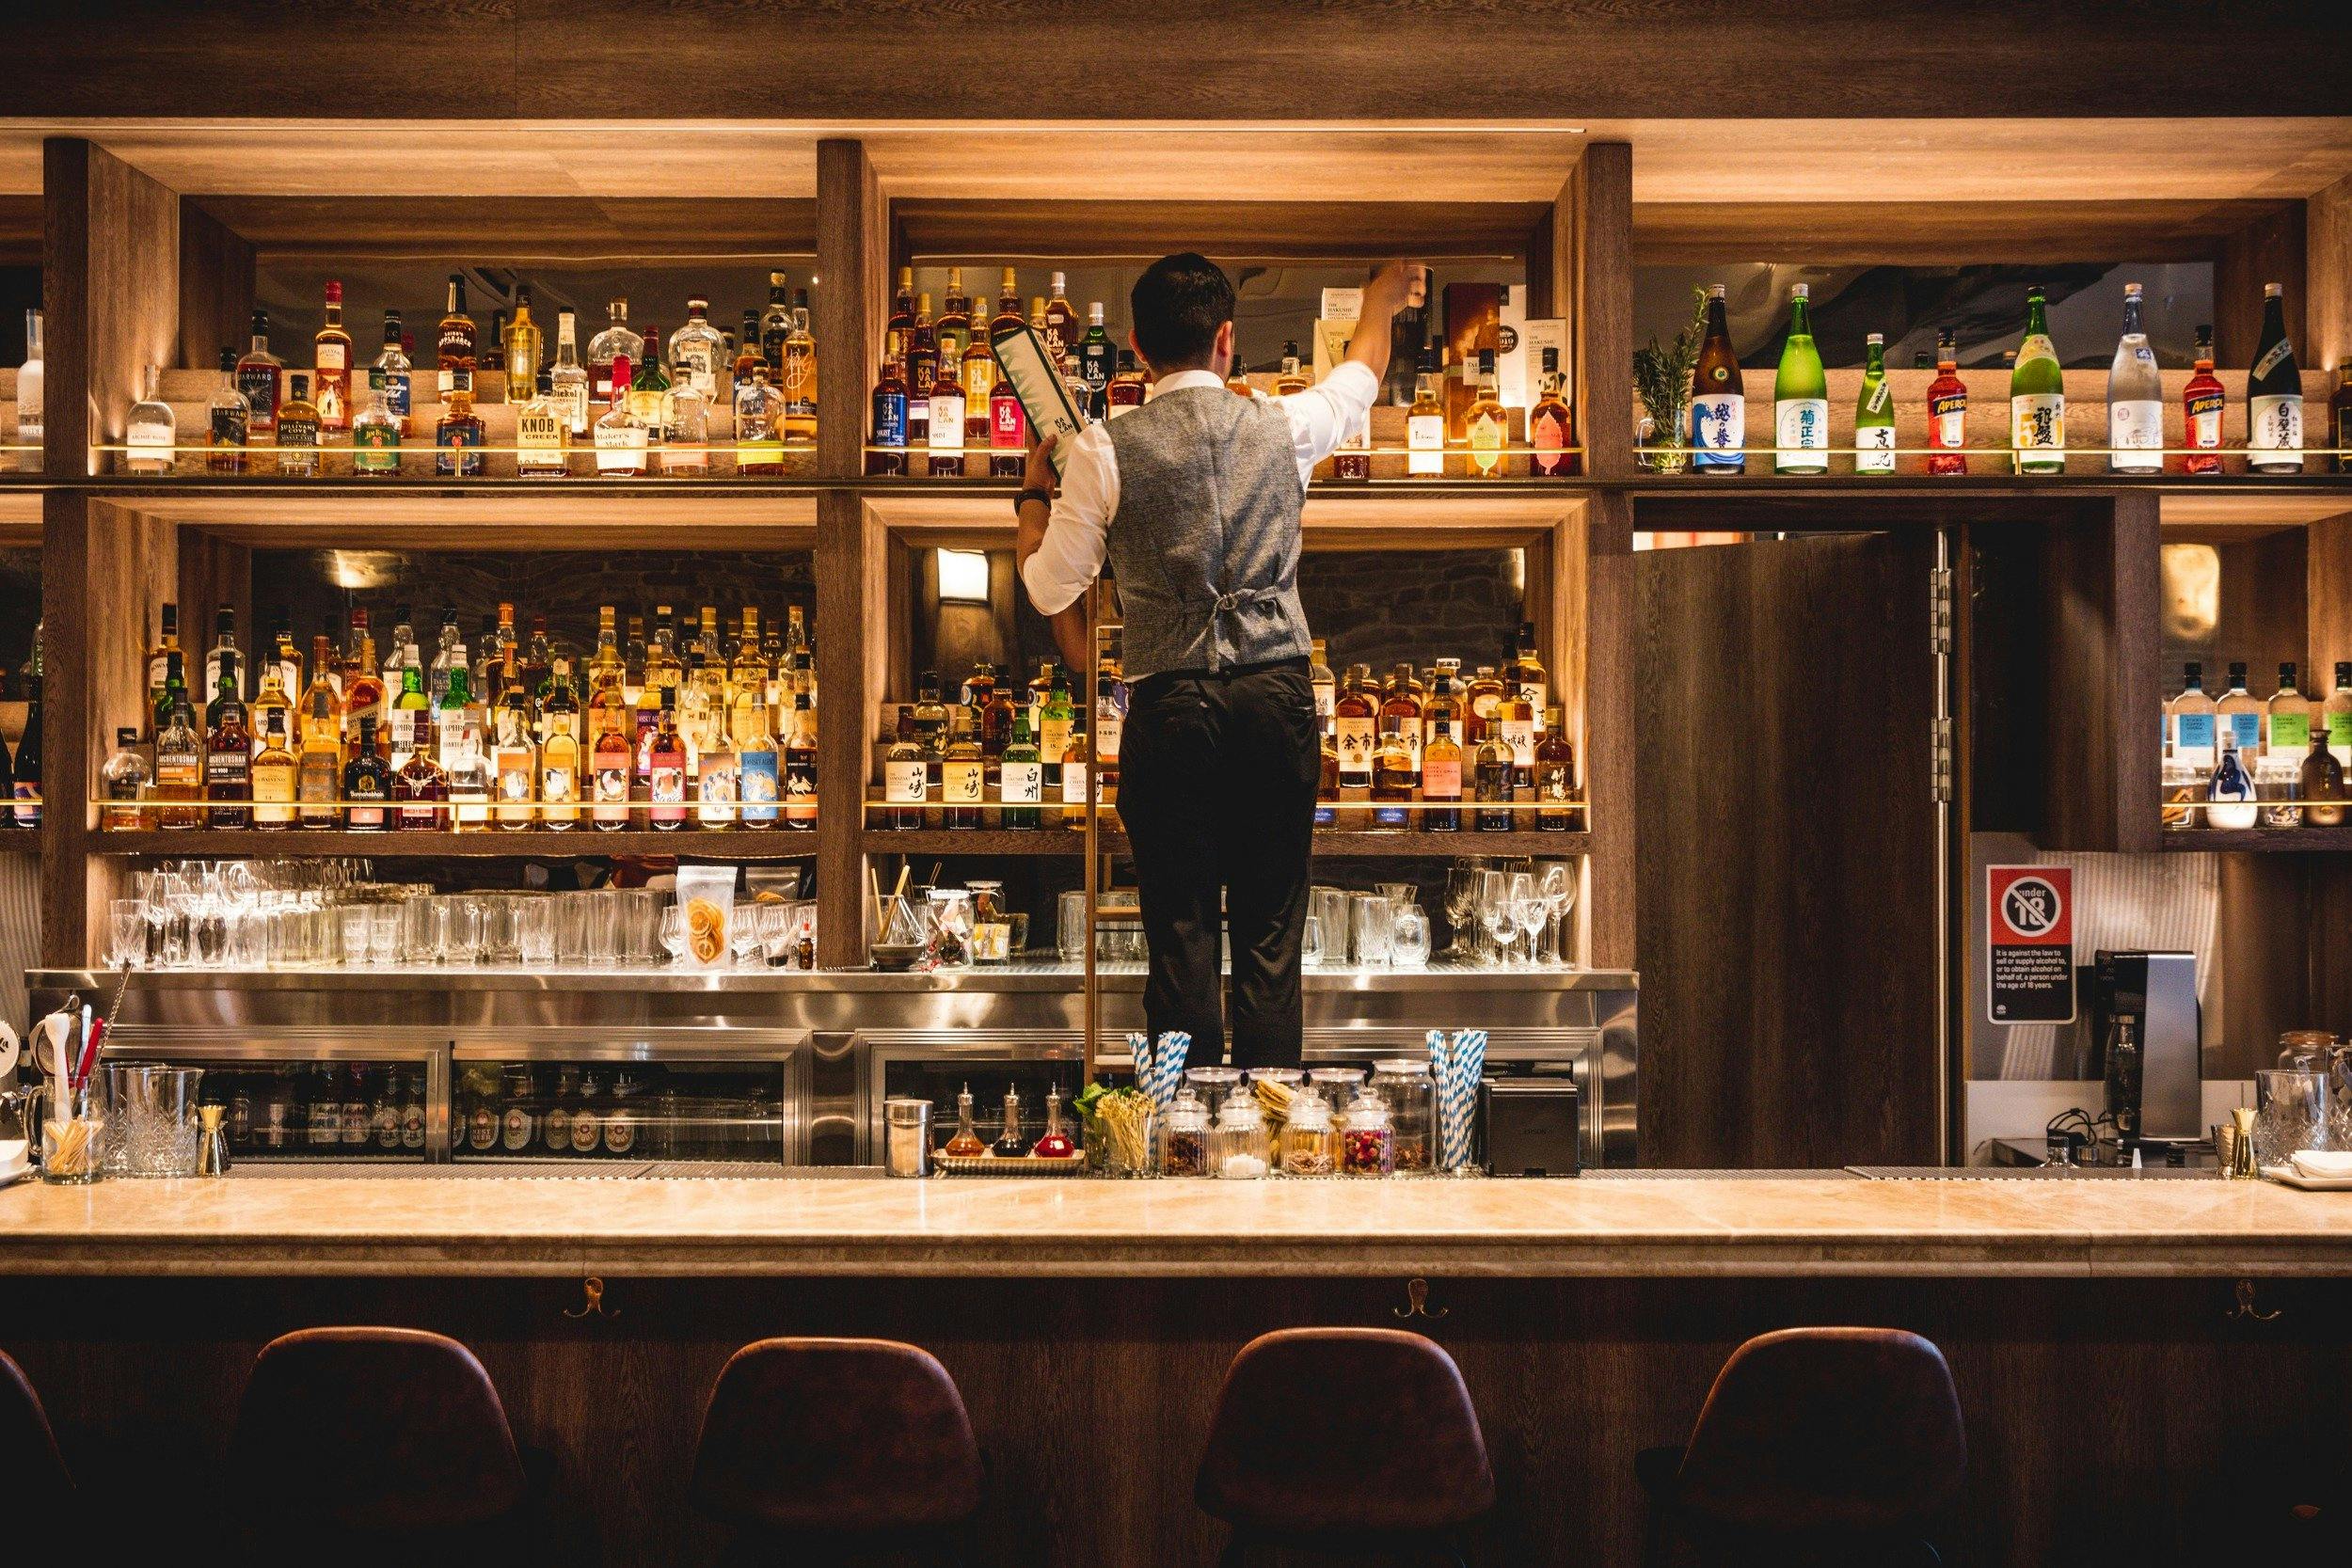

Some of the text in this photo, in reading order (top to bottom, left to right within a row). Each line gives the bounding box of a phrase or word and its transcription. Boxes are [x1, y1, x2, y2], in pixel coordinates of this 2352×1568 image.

[280, 423, 316, 432] SULLIVANS
[521, 418, 554, 433] KNOB
[596, 434, 630, 442] Maker's
[441, 723, 465, 732] LAPHRO
[1342, 733, 1373, 751] 余市
[908, 768, 925, 799] 山崎
[964, 768, 980, 799] 山崎
[1025, 768, 1039, 800] 白州
[2019, 888, 2046, 897] under
[2014, 896, 2045, 926] 18
